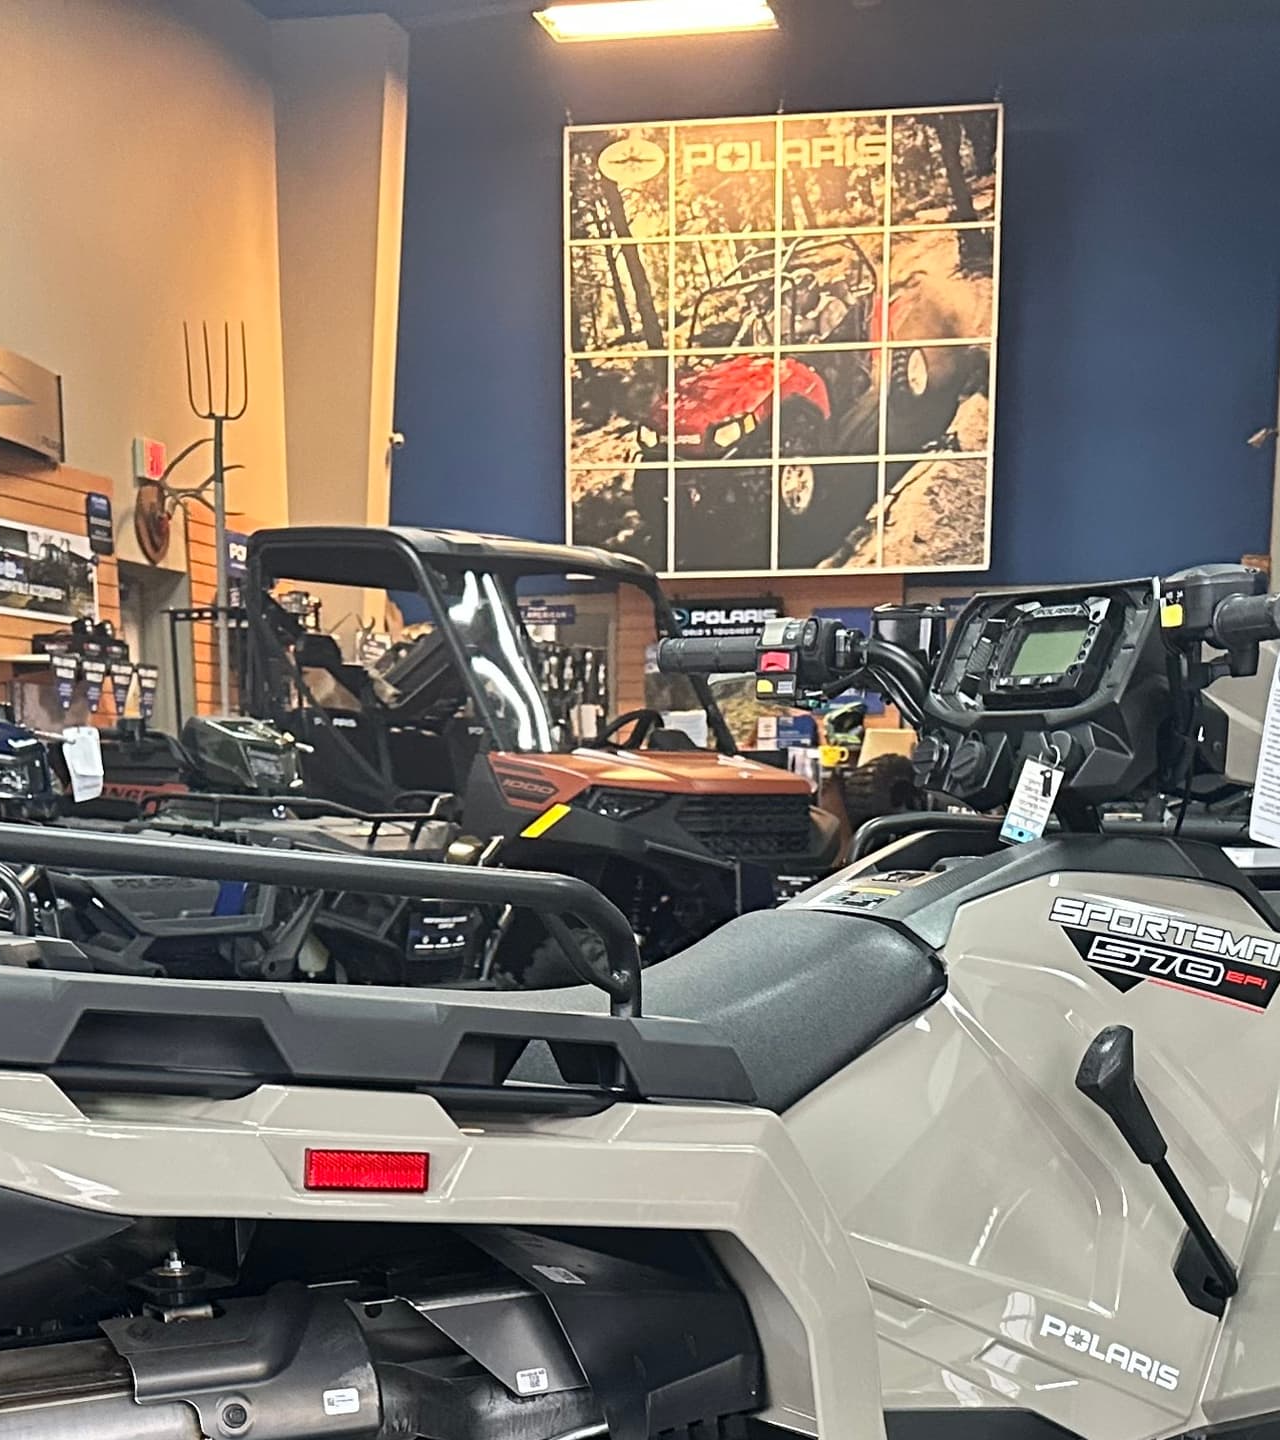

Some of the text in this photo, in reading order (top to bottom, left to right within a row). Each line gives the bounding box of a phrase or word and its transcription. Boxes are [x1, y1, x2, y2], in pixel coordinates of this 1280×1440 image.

[683, 134, 887, 174] POLARIS
[690, 608, 778, 625] POLARIS
[502, 778, 556, 795] 1000
[1087, 935, 1269, 990] 570 EFI
[1039, 1313, 1180, 1391] POLARIS
